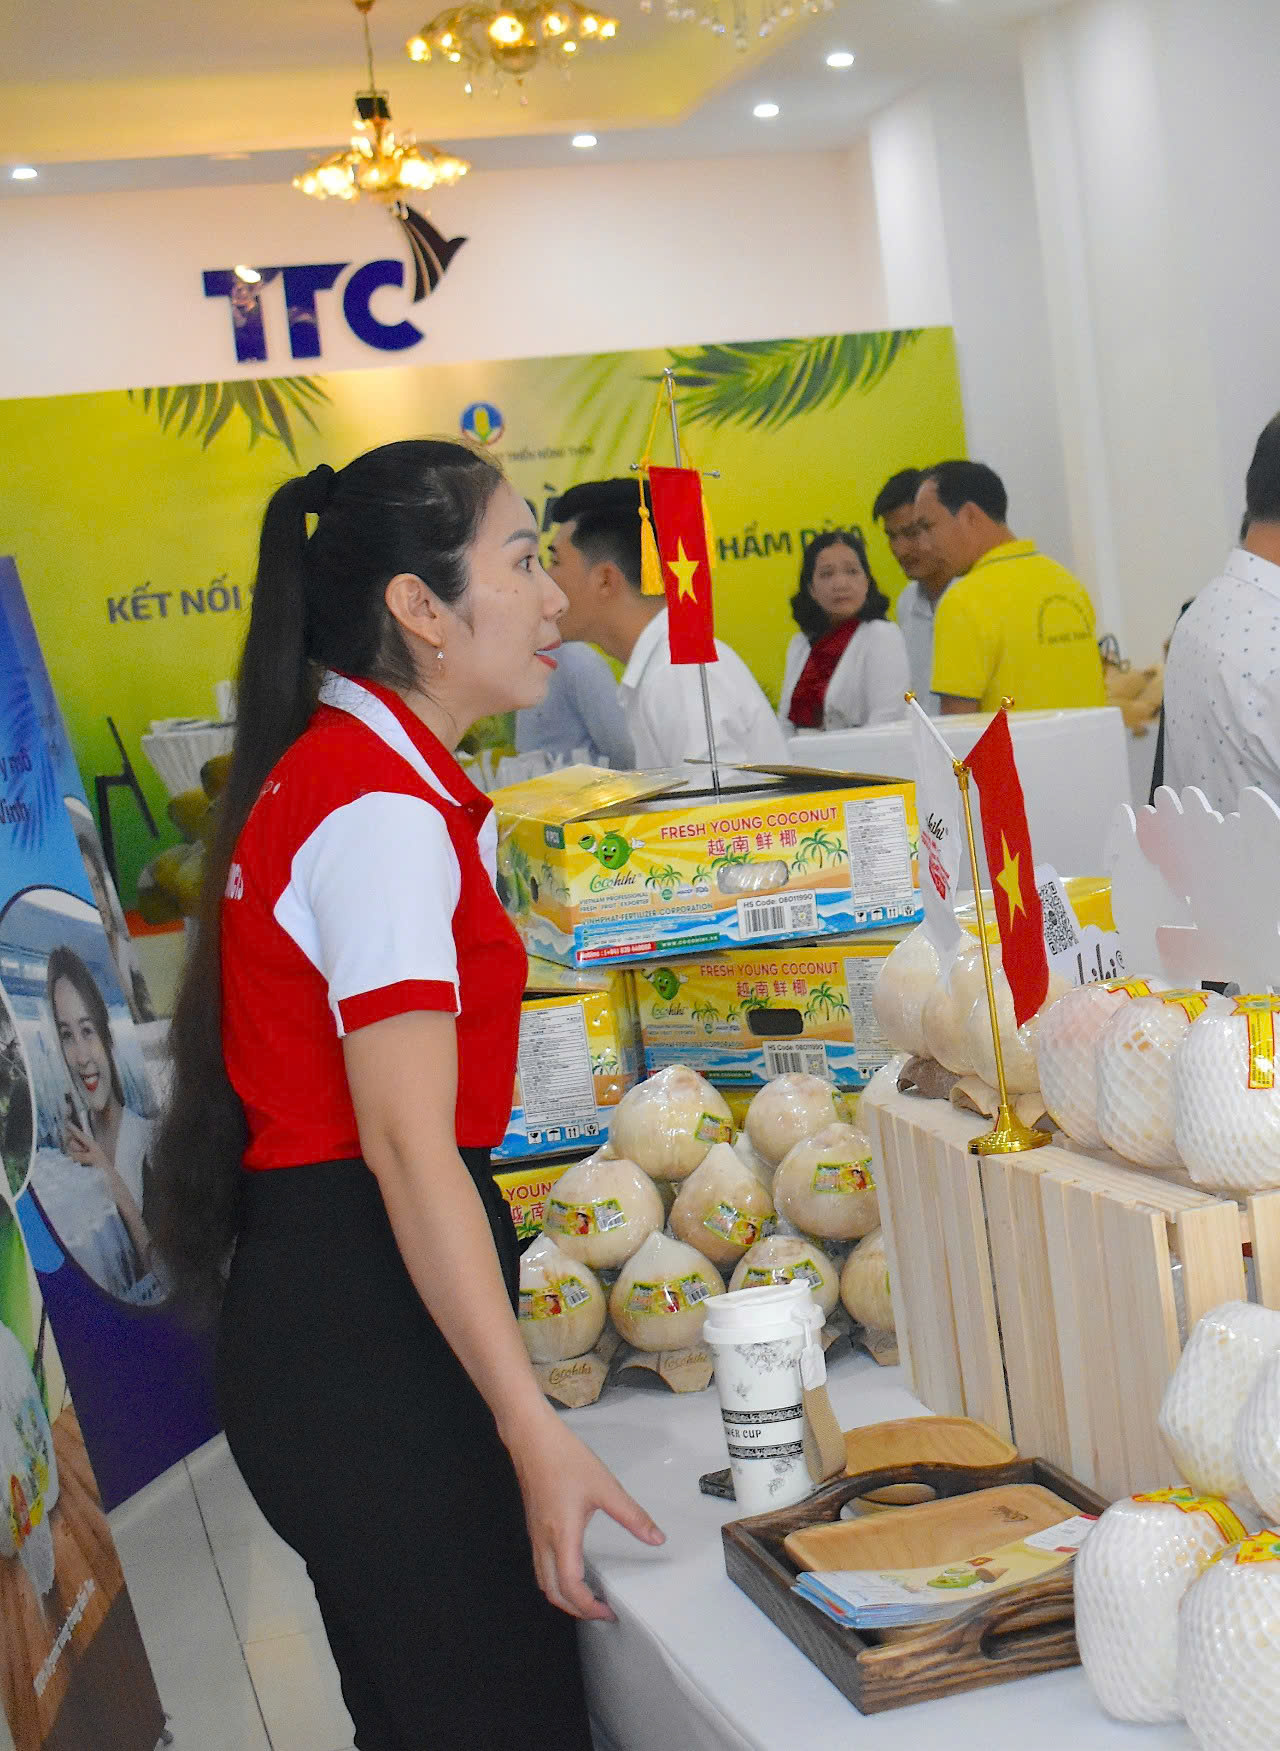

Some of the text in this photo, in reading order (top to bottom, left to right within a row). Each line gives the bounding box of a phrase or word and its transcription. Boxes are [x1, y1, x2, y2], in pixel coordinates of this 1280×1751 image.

[202, 259, 425, 364] TTC
[107, 573, 242, 624] KẾT NỐI
[661, 807, 837, 840] FRESH YOUNG COCONUT
[707, 829, 798, 857] 越南鲜椰
[659, 903, 713, 915] CORPORATION
[700, 962, 839, 977] FRESH YOUNG COCONUT
[506, 1181, 557, 1201] YOUN
[743, 1429, 761, 1438] CUP
